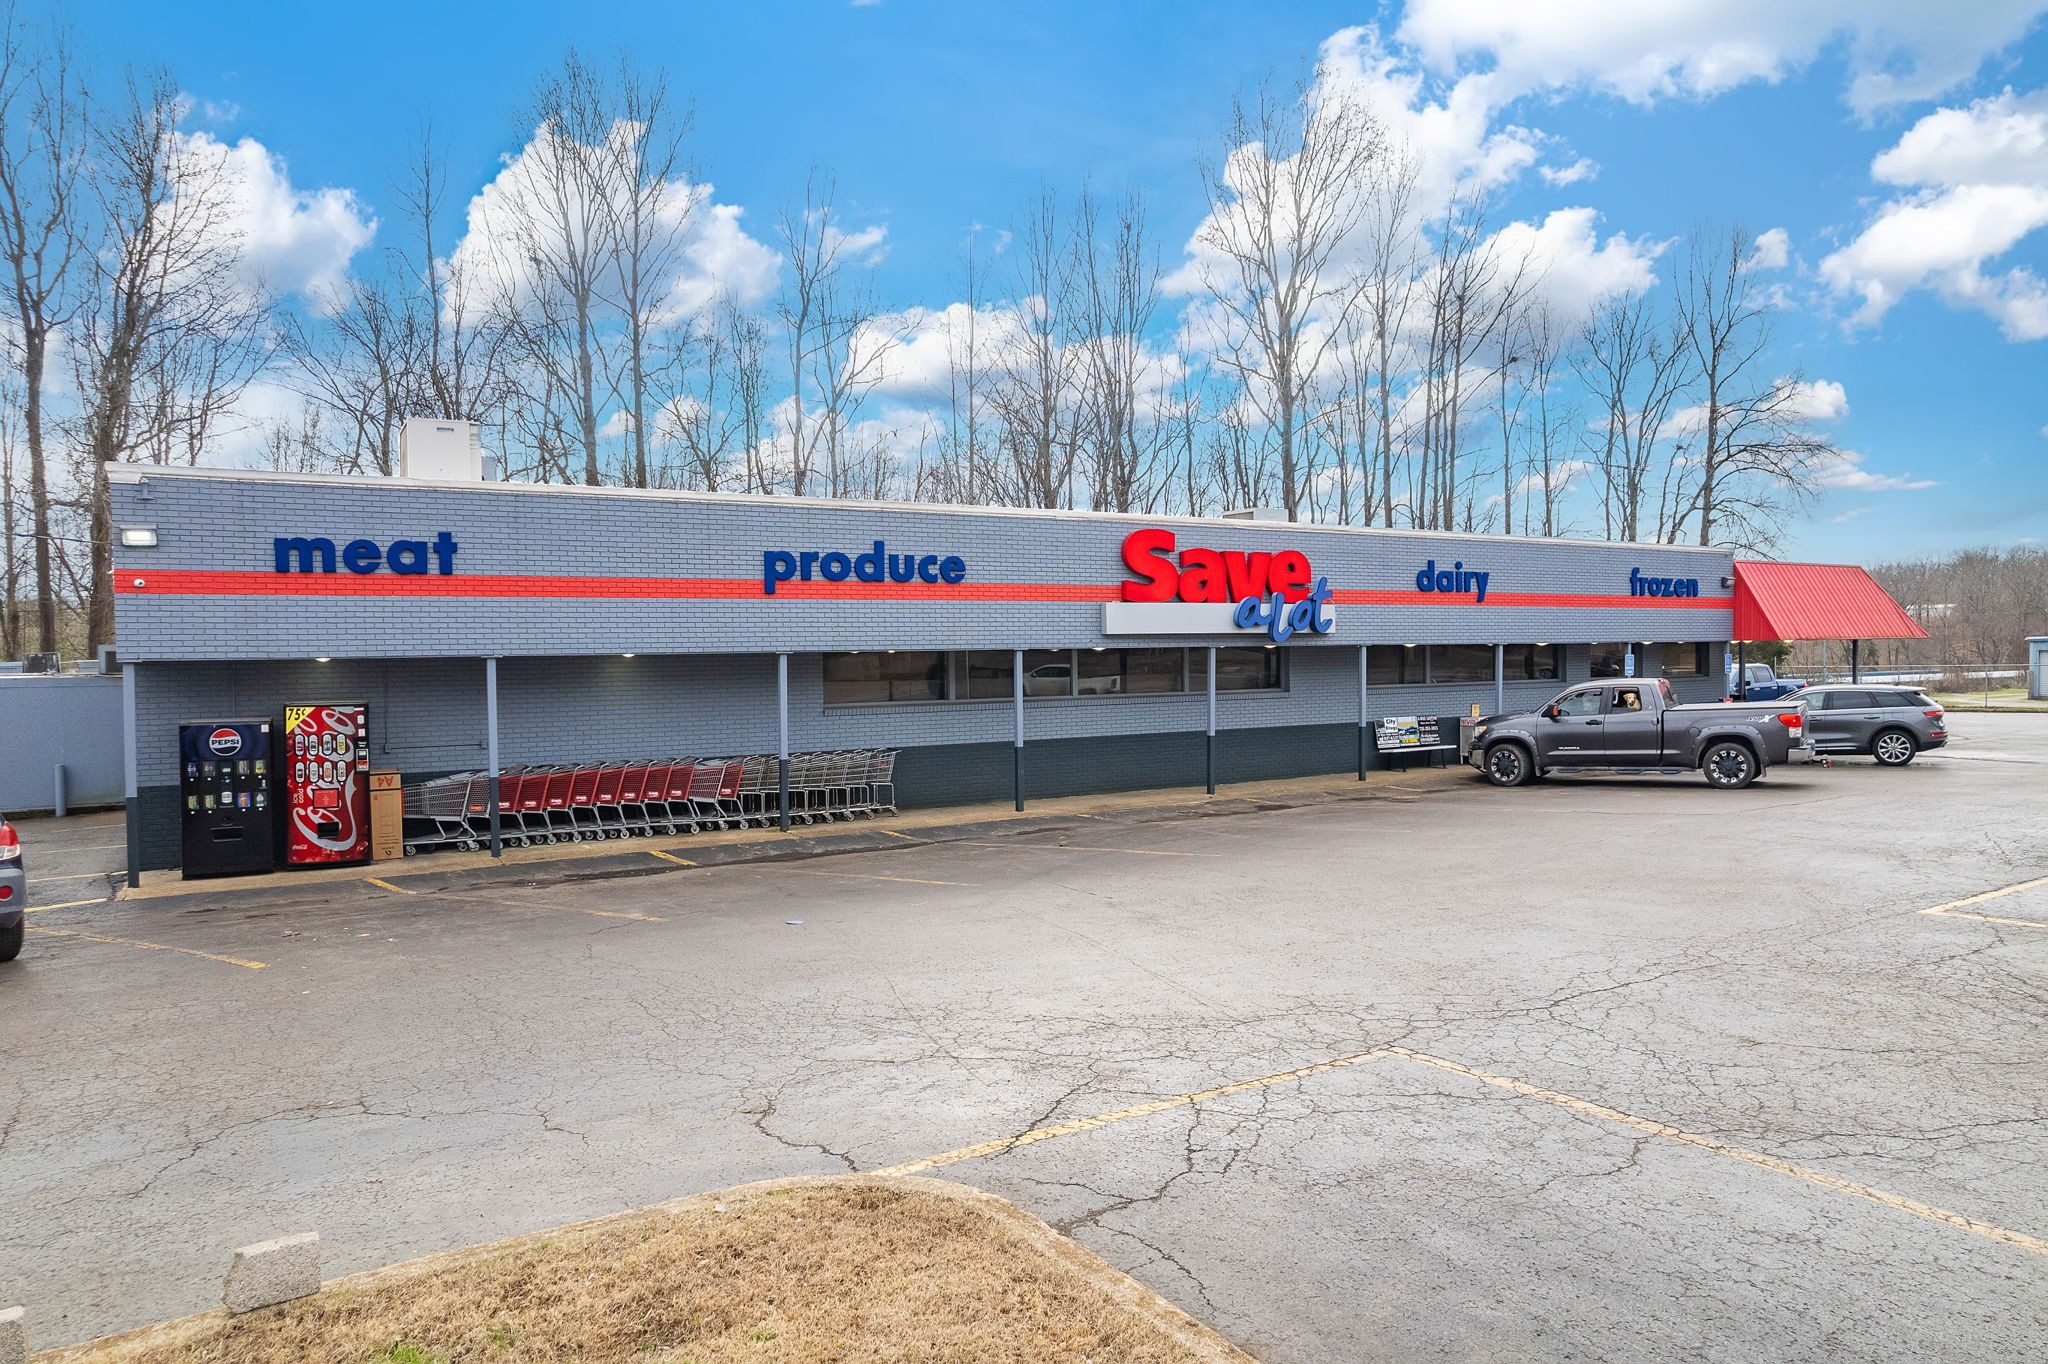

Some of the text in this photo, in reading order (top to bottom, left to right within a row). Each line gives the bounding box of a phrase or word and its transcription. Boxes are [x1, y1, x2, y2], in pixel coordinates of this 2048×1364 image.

[274, 532, 458, 574] meat
[764, 541, 966, 594] produce
[1121, 529, 1311, 603] Save
[1416, 560, 1489, 602] dairy
[1630, 567, 1698, 597] frozen
[211, 738, 240, 746] PEPSI
[1386, 718, 1396, 726] City
